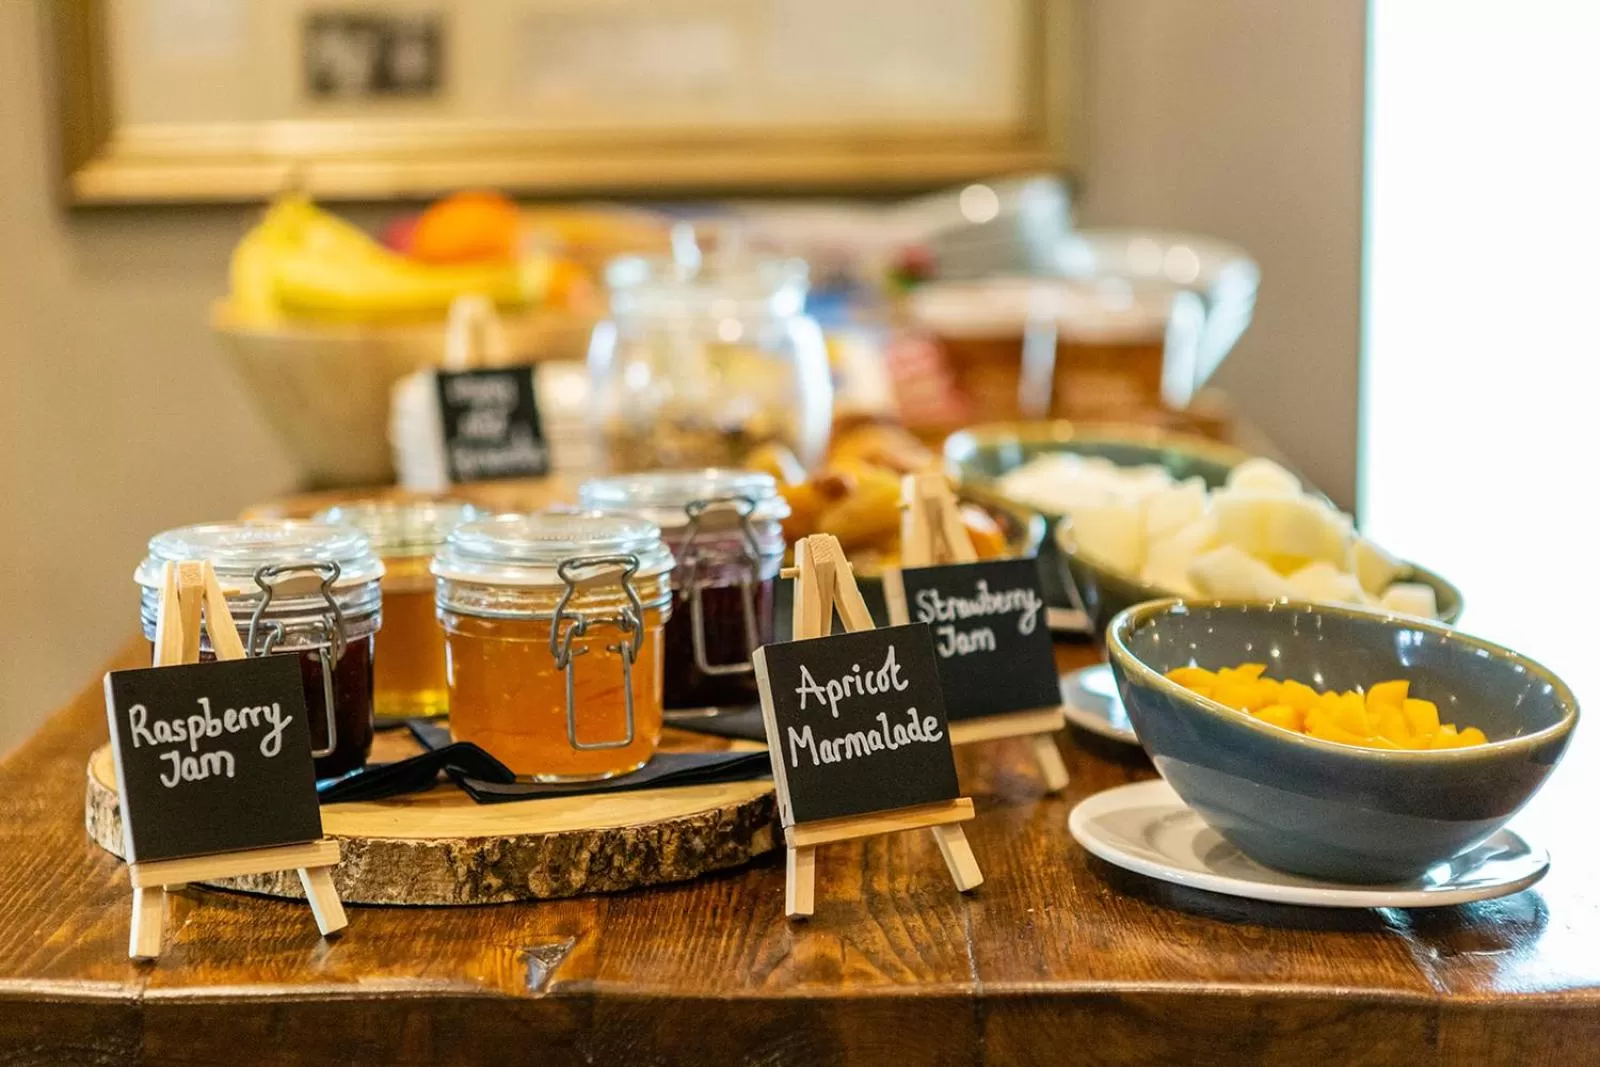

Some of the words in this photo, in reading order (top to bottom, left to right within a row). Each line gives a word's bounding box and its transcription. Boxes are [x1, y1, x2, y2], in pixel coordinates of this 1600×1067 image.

[916, 579, 1042, 635] Strawberry
[936, 626, 996, 658] Jam
[795, 645, 909, 718] Apricot
[128, 697, 293, 758] Raspberry
[787, 707, 943, 768] Marmalade
[160, 750, 235, 788] Jam
